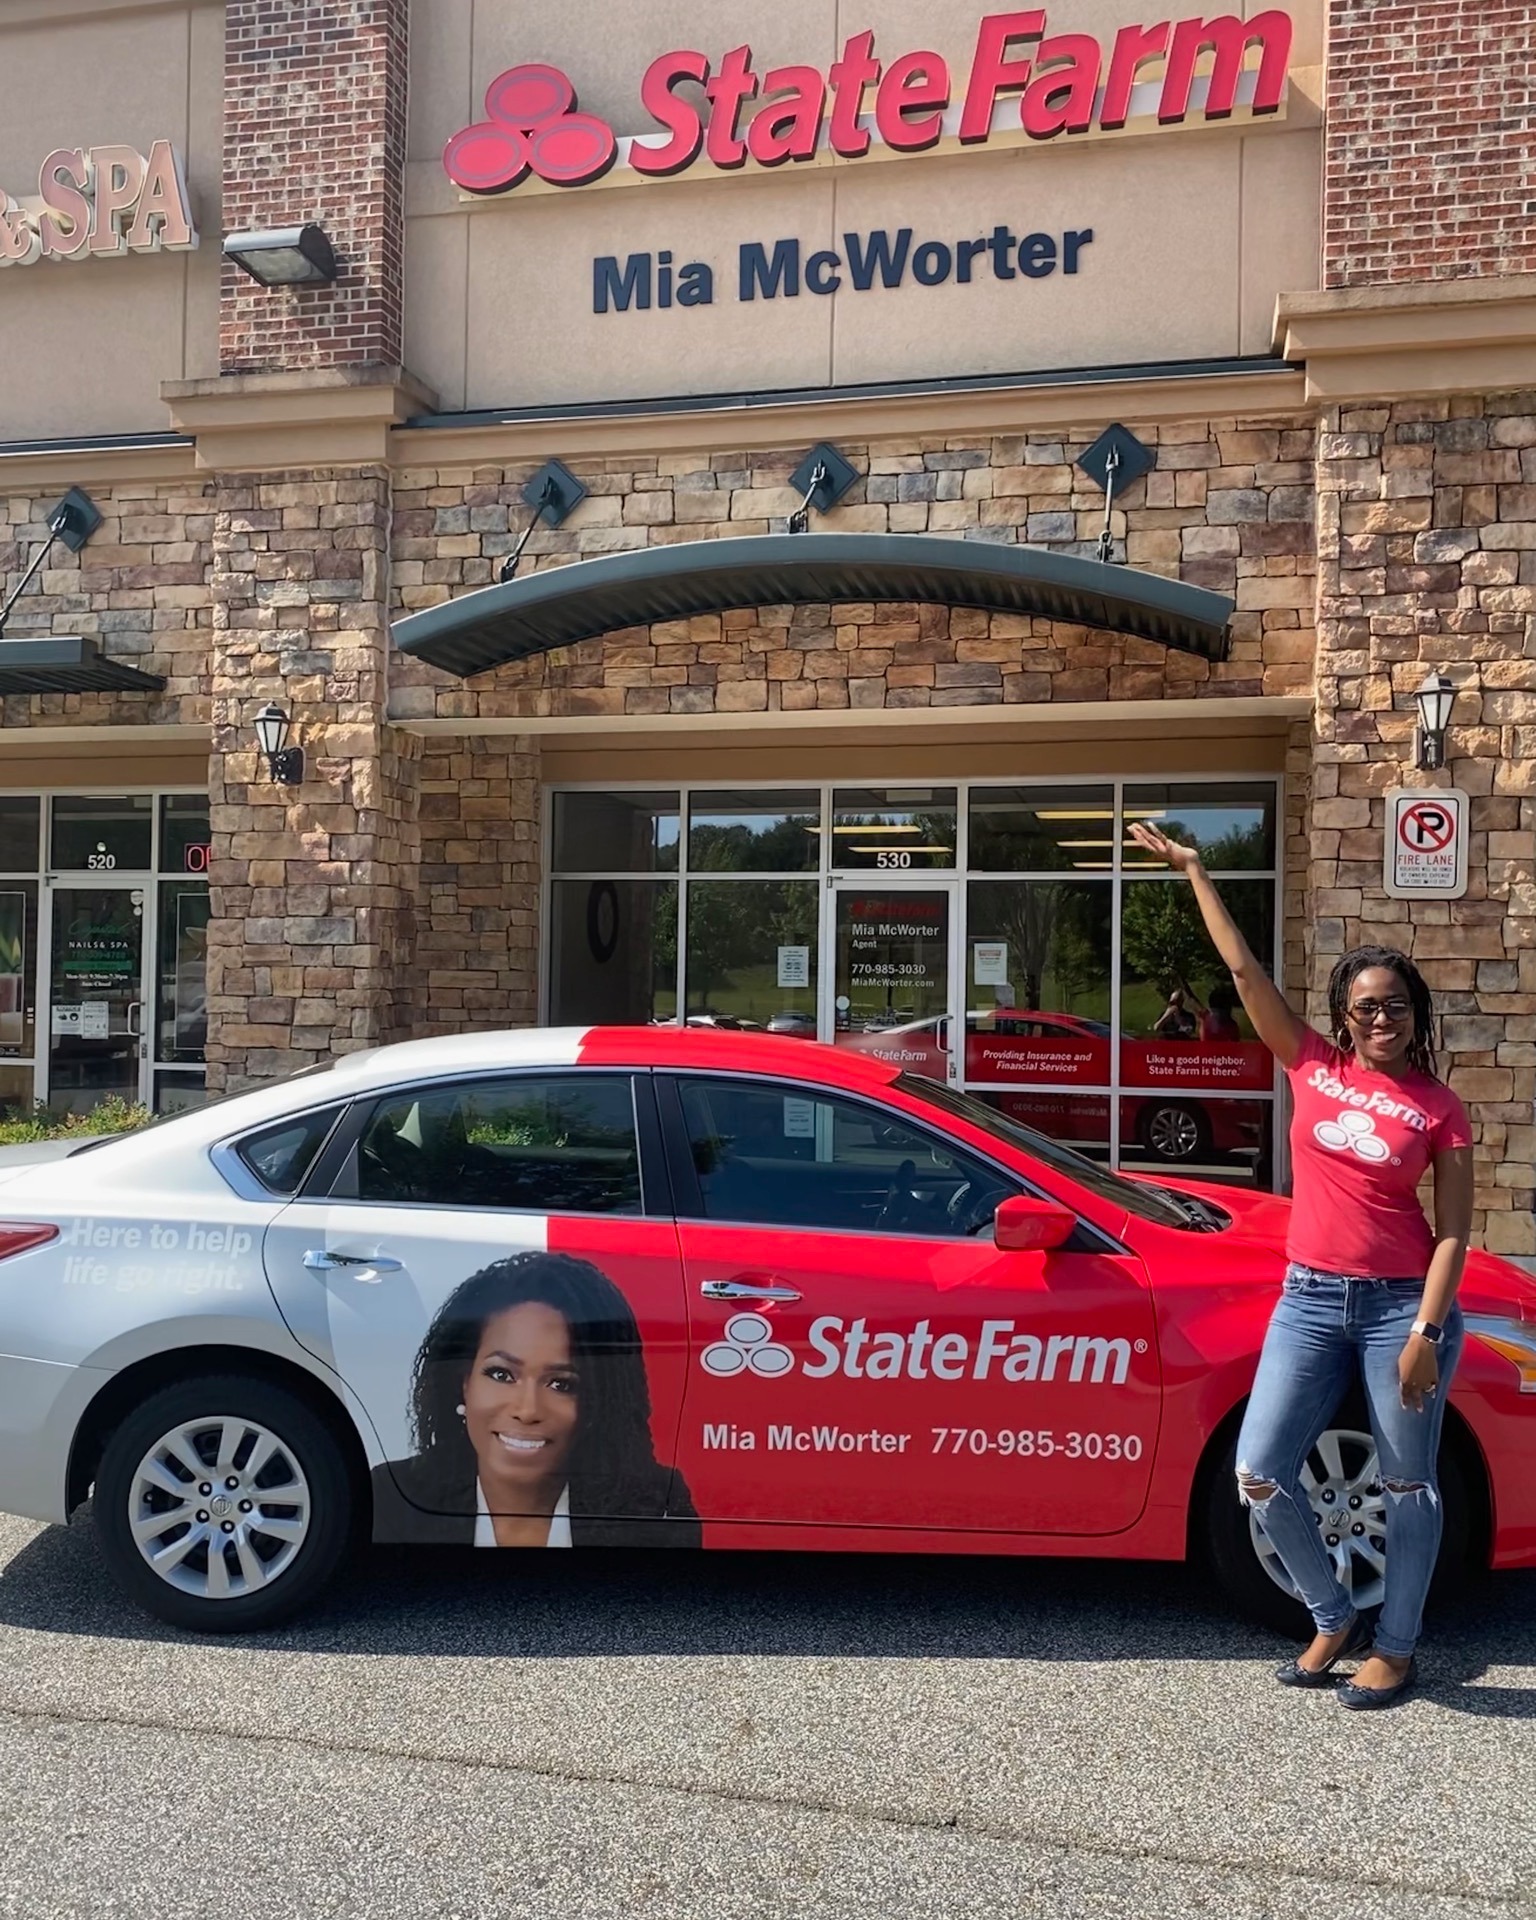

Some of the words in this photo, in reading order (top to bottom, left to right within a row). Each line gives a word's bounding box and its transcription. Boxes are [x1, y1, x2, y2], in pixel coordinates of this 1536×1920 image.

[39, 139, 198, 258] SPA
[594, 251, 713, 313] Mia
[739, 226, 1093, 301] McWorter
[87, 854, 116, 869] 520
[877, 852, 911, 868] 530
[1398, 855, 1421, 865] FIRE
[1426, 855, 1454, 865] LANE
[852, 923, 875, 936] Mia
[878, 923, 940, 936] McWorter
[110, 941, 129, 949] SPA
[852, 939, 878, 950] Agent
[851, 963, 926, 975] 770-985-3030
[851, 978, 935, 988] MiaMcWorter.com
[983, 1049, 1025, 1061] Providing
[1027, 1051, 1072, 1061] Insurance
[1074, 1052, 1093, 1062] and
[1146, 1054, 1166, 1064] Like
[1177, 1055, 1200, 1066] good
[996, 1060, 1038, 1071] Financial
[1039, 1062, 1078, 1073] Services
[1149, 1065, 1174, 1075] State
[1176, 1066, 1200, 1076] Farm
[1202, 1066, 1210, 1076] is
[1307, 1067, 1427, 1131] StateFarm
[70, 1218, 143, 1249] Here
[149, 1223, 180, 1250] to
[186, 1222, 253, 1260] help
[63, 1256, 109, 1286] life
[115, 1264, 154, 1292] go
[163, 1259, 244, 1295] right.
[702, 1423, 756, 1451] Mia
[767, 1424, 911, 1453] McWorter
[931, 1427, 1143, 1462] 770-985-3030
